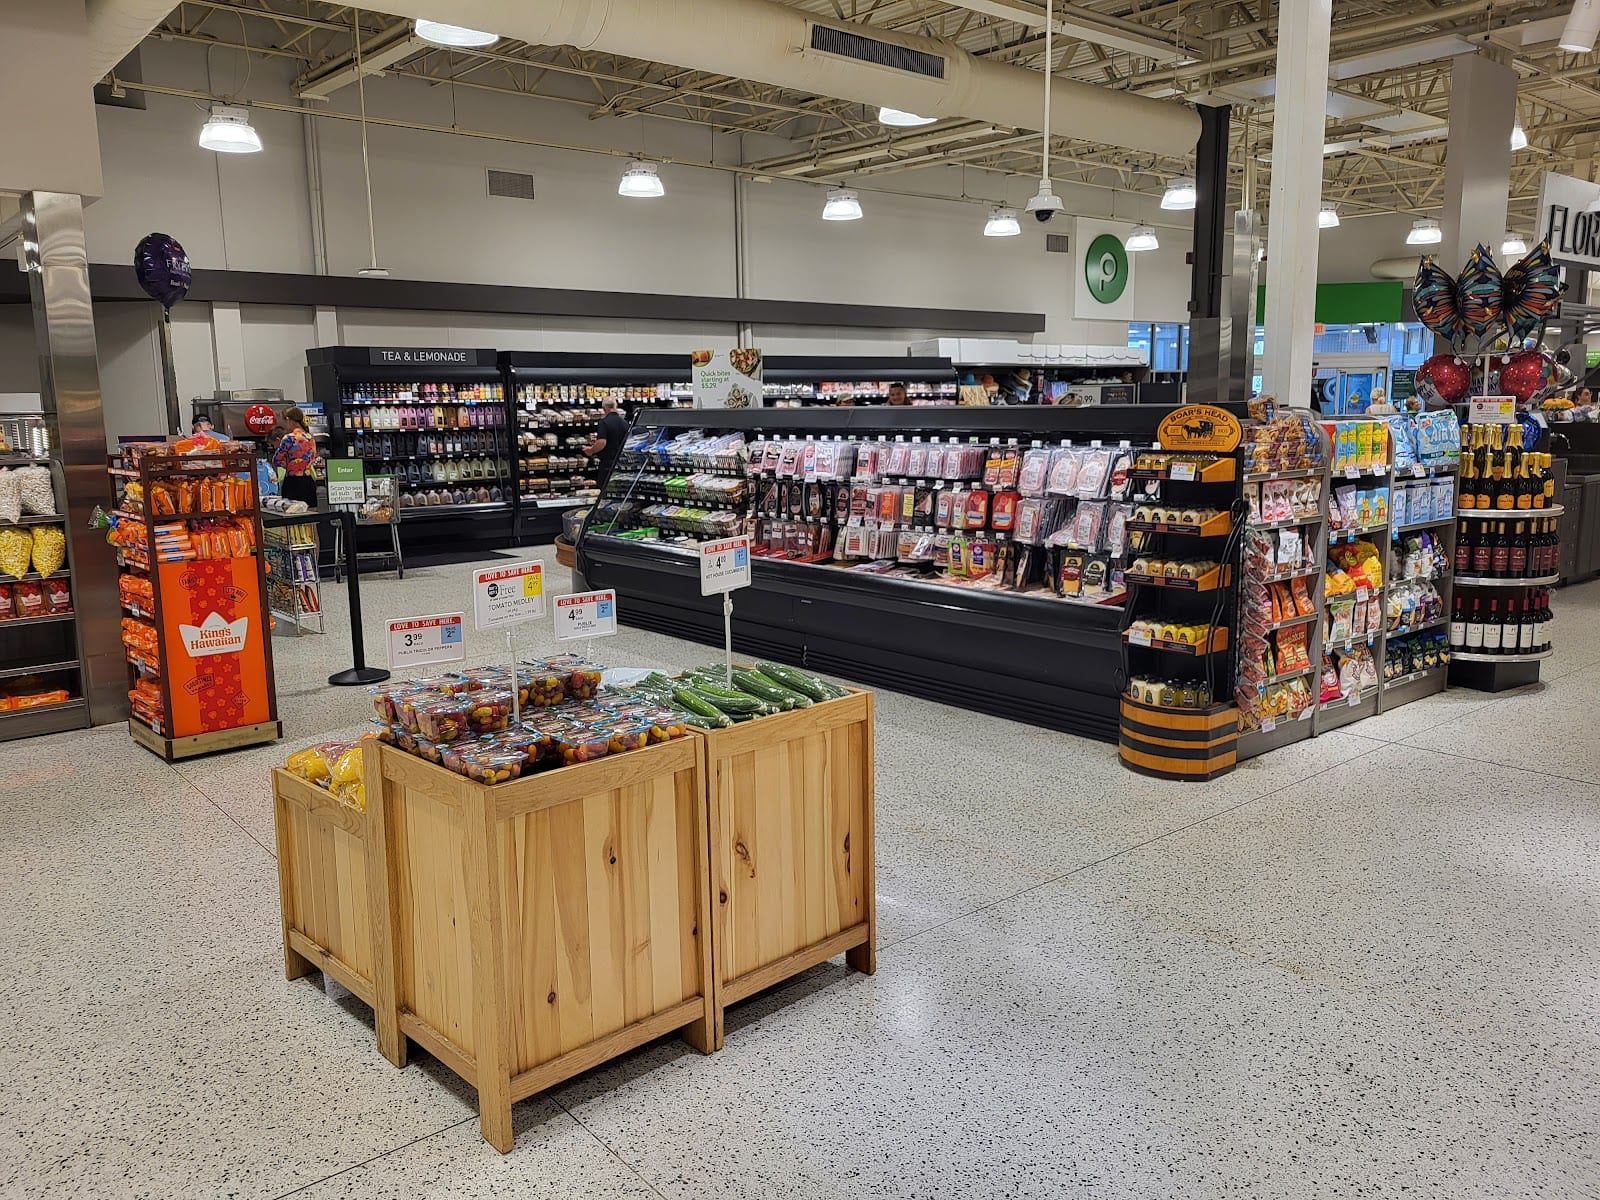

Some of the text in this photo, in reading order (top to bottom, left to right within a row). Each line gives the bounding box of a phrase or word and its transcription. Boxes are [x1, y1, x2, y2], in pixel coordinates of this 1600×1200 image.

[382, 351, 467, 362] TEA & LEMONADE
[1170, 408, 1228, 422] BOAR'S HEAD
[500, 584, 516, 596] Free
[488, 601, 512, 611] TOMATO
[514, 597, 534, 606] MEDLEY
[200, 627, 232, 640] King's
[190, 635, 242, 650] Hawaiian
